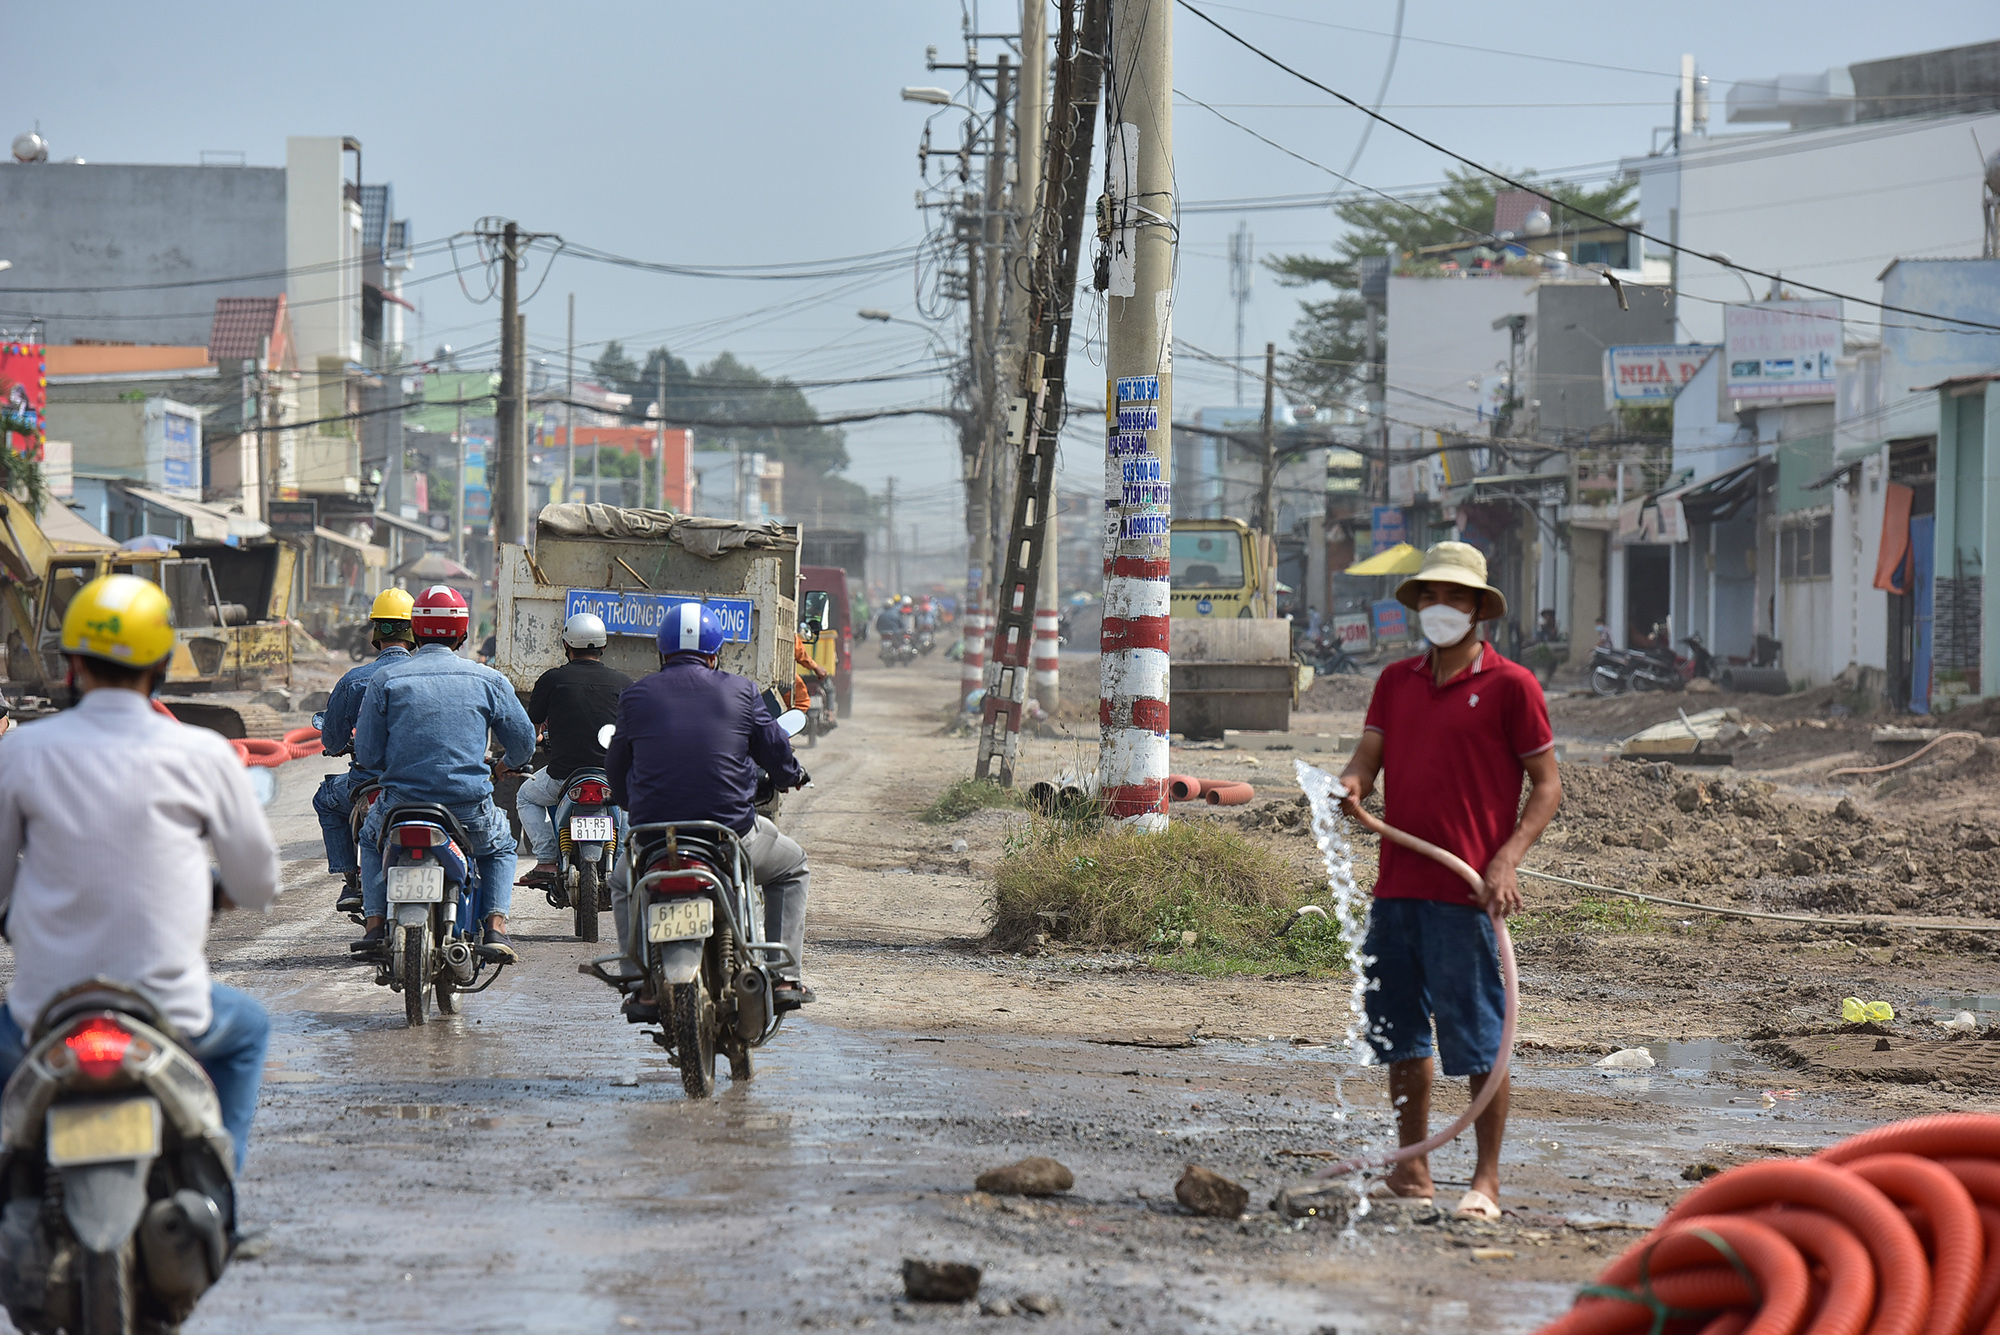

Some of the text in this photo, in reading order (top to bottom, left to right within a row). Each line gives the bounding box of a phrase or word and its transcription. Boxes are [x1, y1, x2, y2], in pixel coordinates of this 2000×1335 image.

[1619, 358, 1673, 385] NHÀ
[1170, 593, 1242, 601] DYNAPAC
[606, 597, 654, 627] TRƯỜNG
[577, 829, 606, 839] 8117
[395, 885, 434, 899] 5792
[653, 919, 708, 939] 764.96
